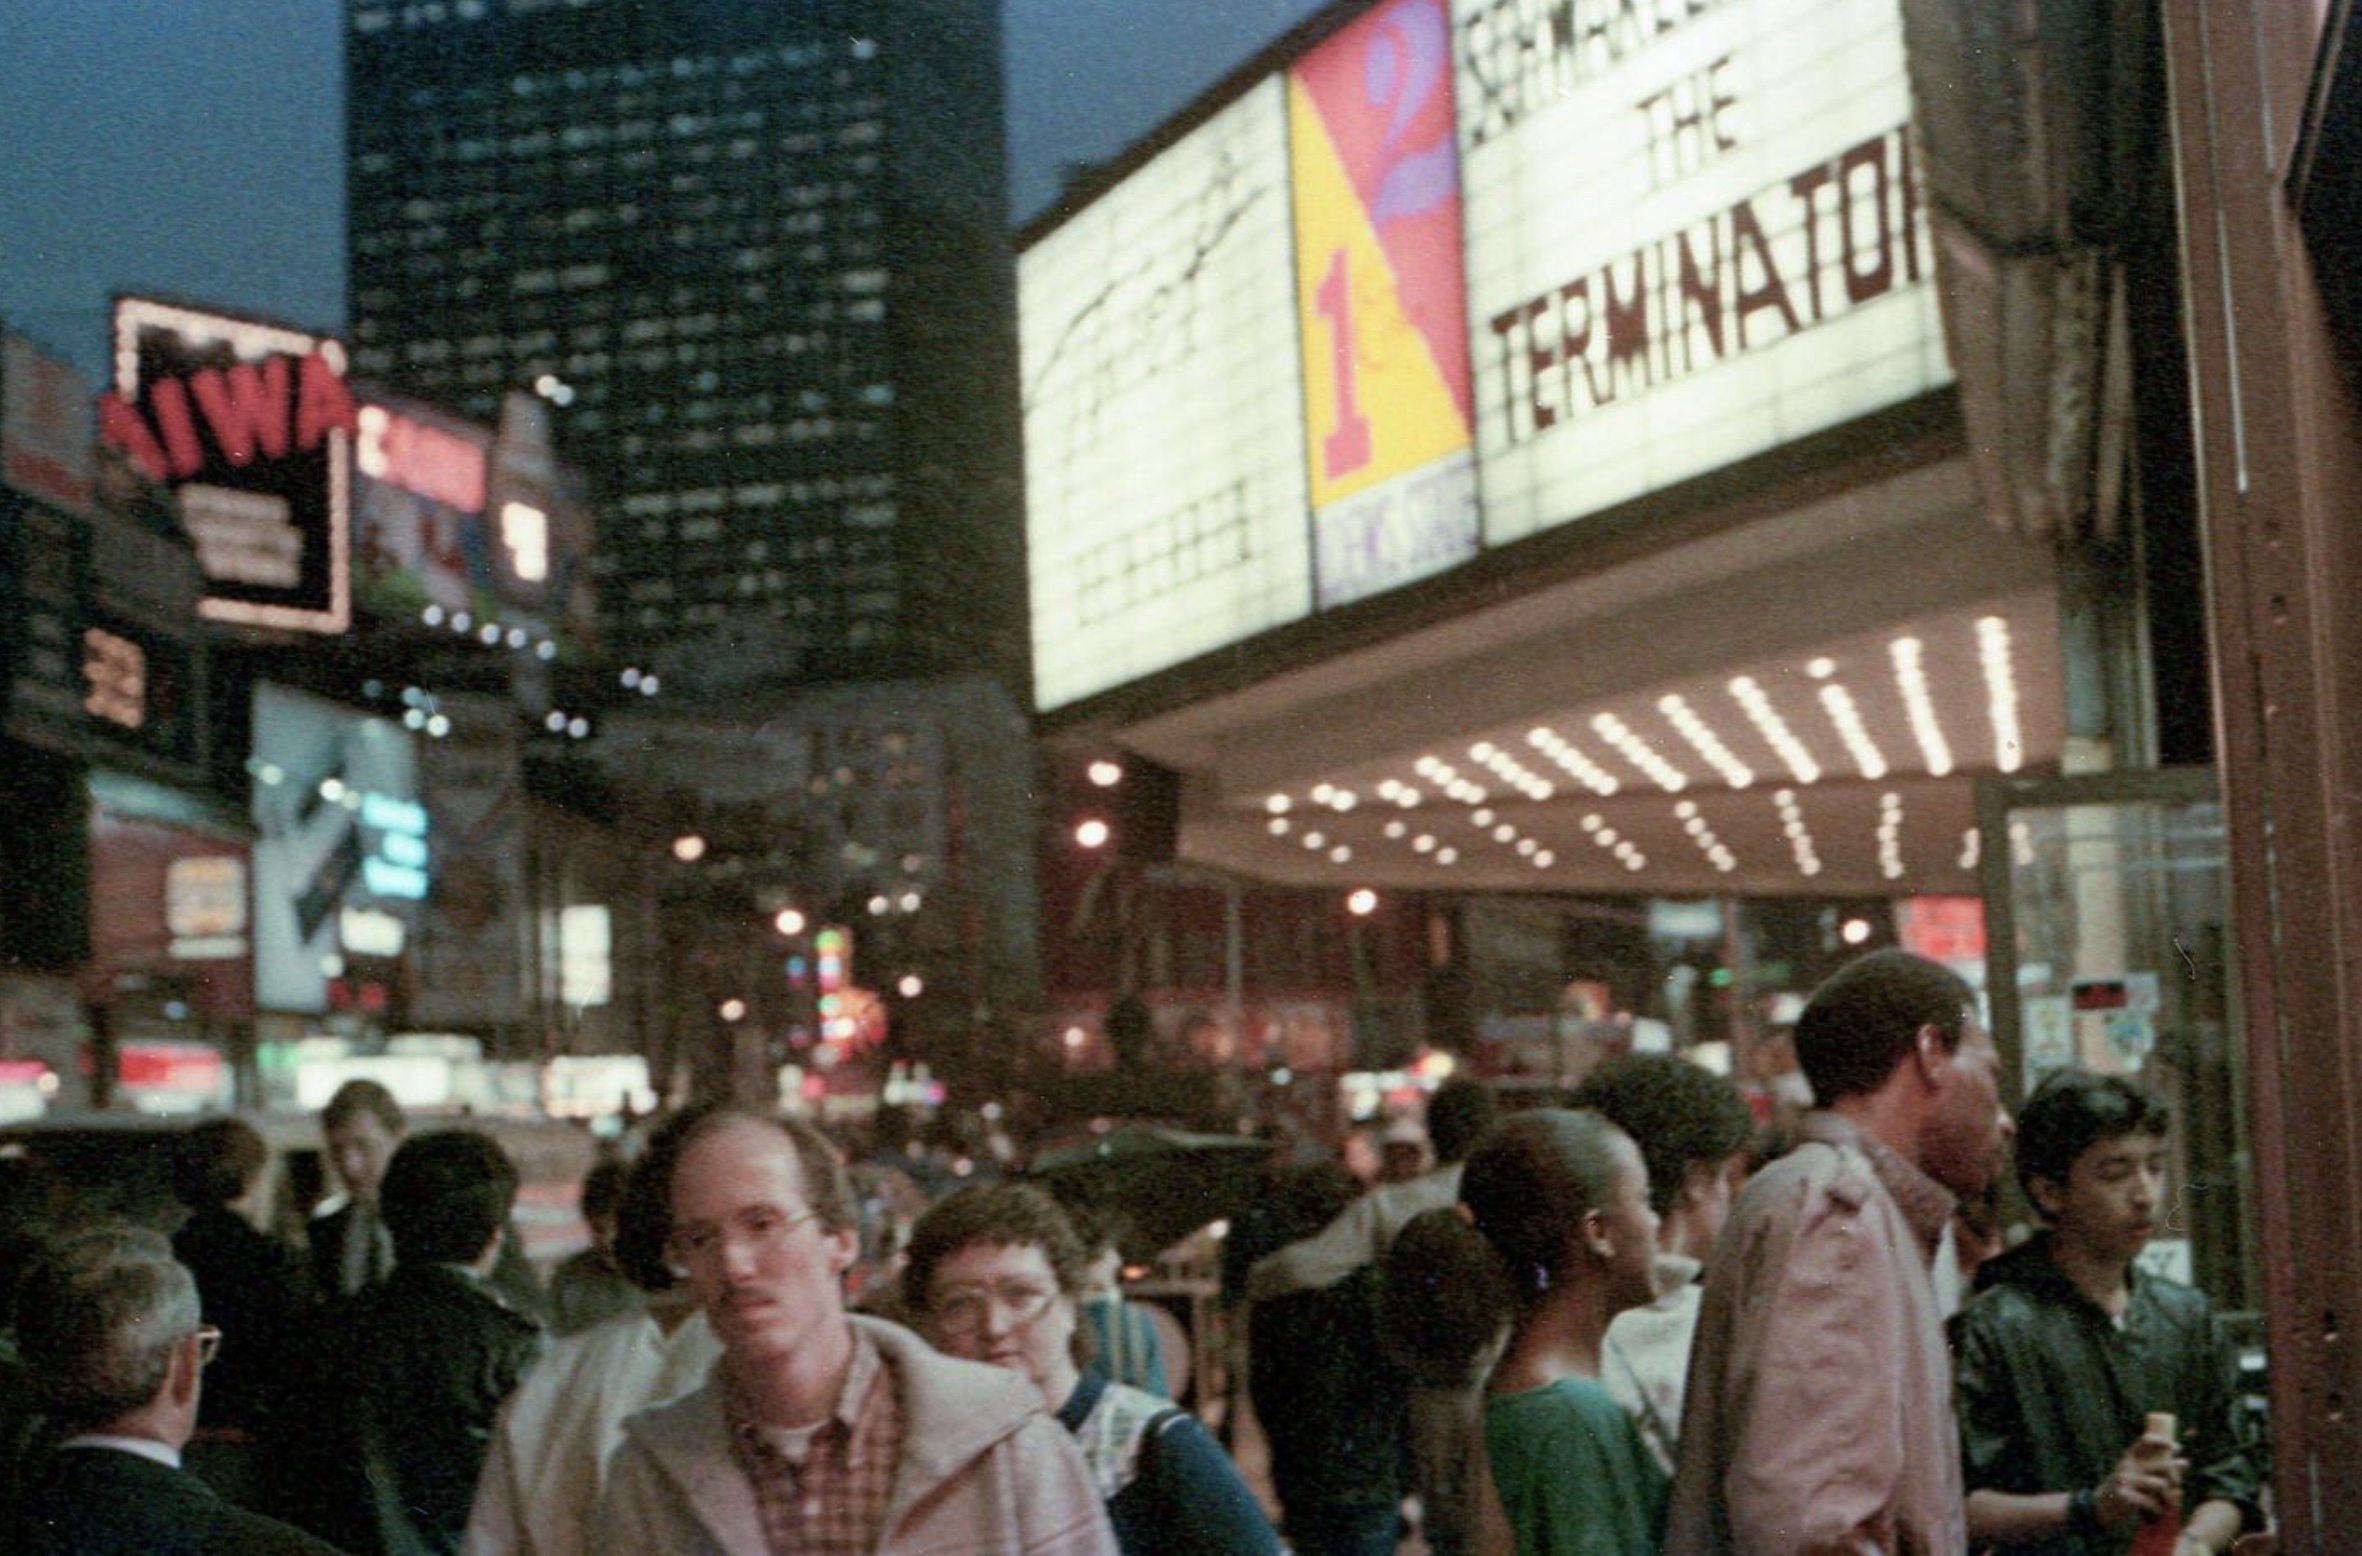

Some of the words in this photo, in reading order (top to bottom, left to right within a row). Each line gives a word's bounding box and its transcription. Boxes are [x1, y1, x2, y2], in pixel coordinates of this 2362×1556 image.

[1364, 0, 1458, 223] 2
[1634, 54, 1738, 187] THE
[1314, 247, 1372, 482] 1
